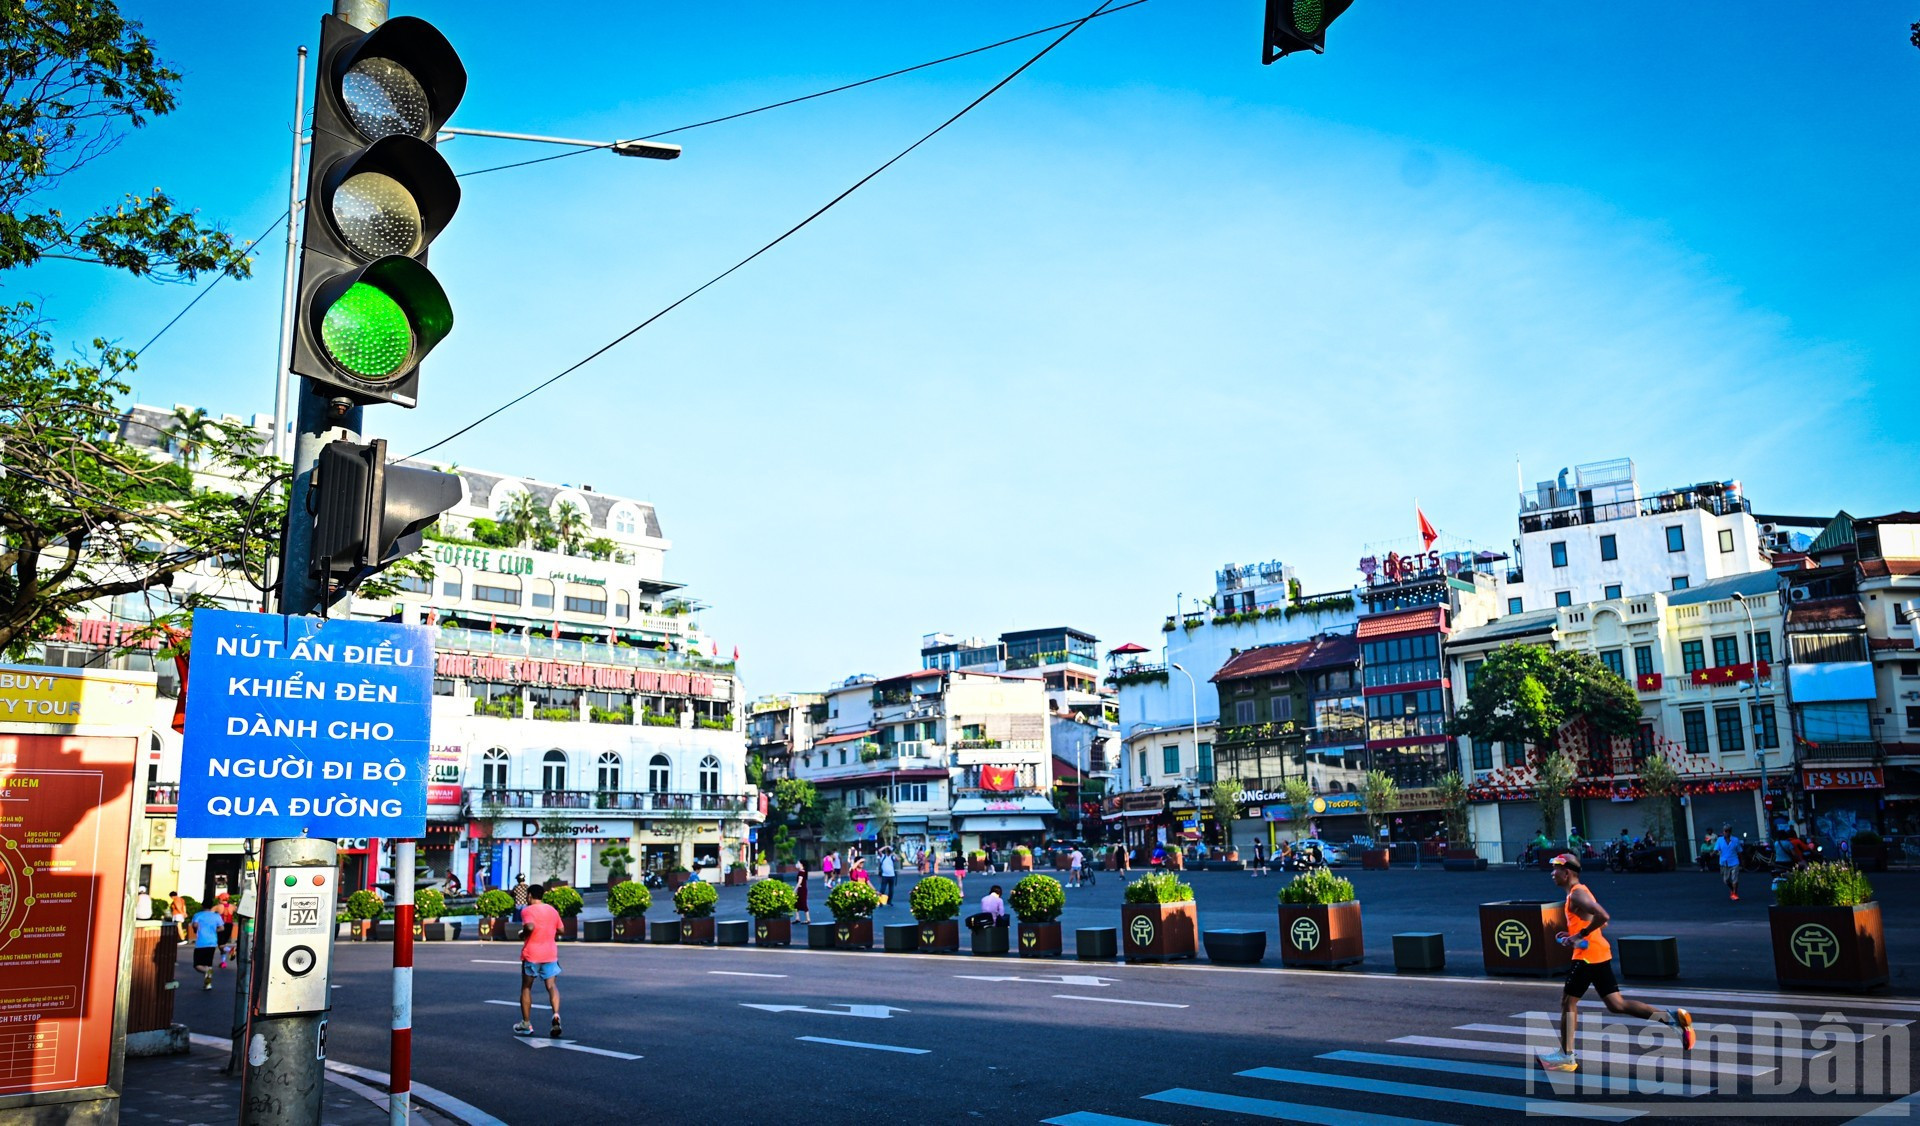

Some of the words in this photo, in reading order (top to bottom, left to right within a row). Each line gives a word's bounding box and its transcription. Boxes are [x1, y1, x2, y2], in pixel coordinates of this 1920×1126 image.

[435, 545, 490, 571] COFFEE
[498, 554, 534, 575] CLUB
[216, 634, 282, 658] NÚT
[290, 636, 333, 661] ẤN
[343, 640, 413, 666] ĐIỀU
[229, 671, 324, 700] KHIỂN
[335, 679, 397, 702] ĐÈN
[24, 699, 81, 715] TOUR
[227, 713, 317, 738] DÀNH
[328, 721, 394, 741] CHO
[208, 755, 313, 779] NGƯỜI
[322, 761, 352, 779] ĐI
[362, 758, 406, 786] BỘ
[436, 764, 459, 777] CLUB
[1837, 770, 1878, 785] SPA
[207, 796, 279, 817] QUA
[288, 793, 402, 818] ĐƯỜNG
[337, 837, 367, 849] KFC
[23, 1013, 41, 1021] STOP
